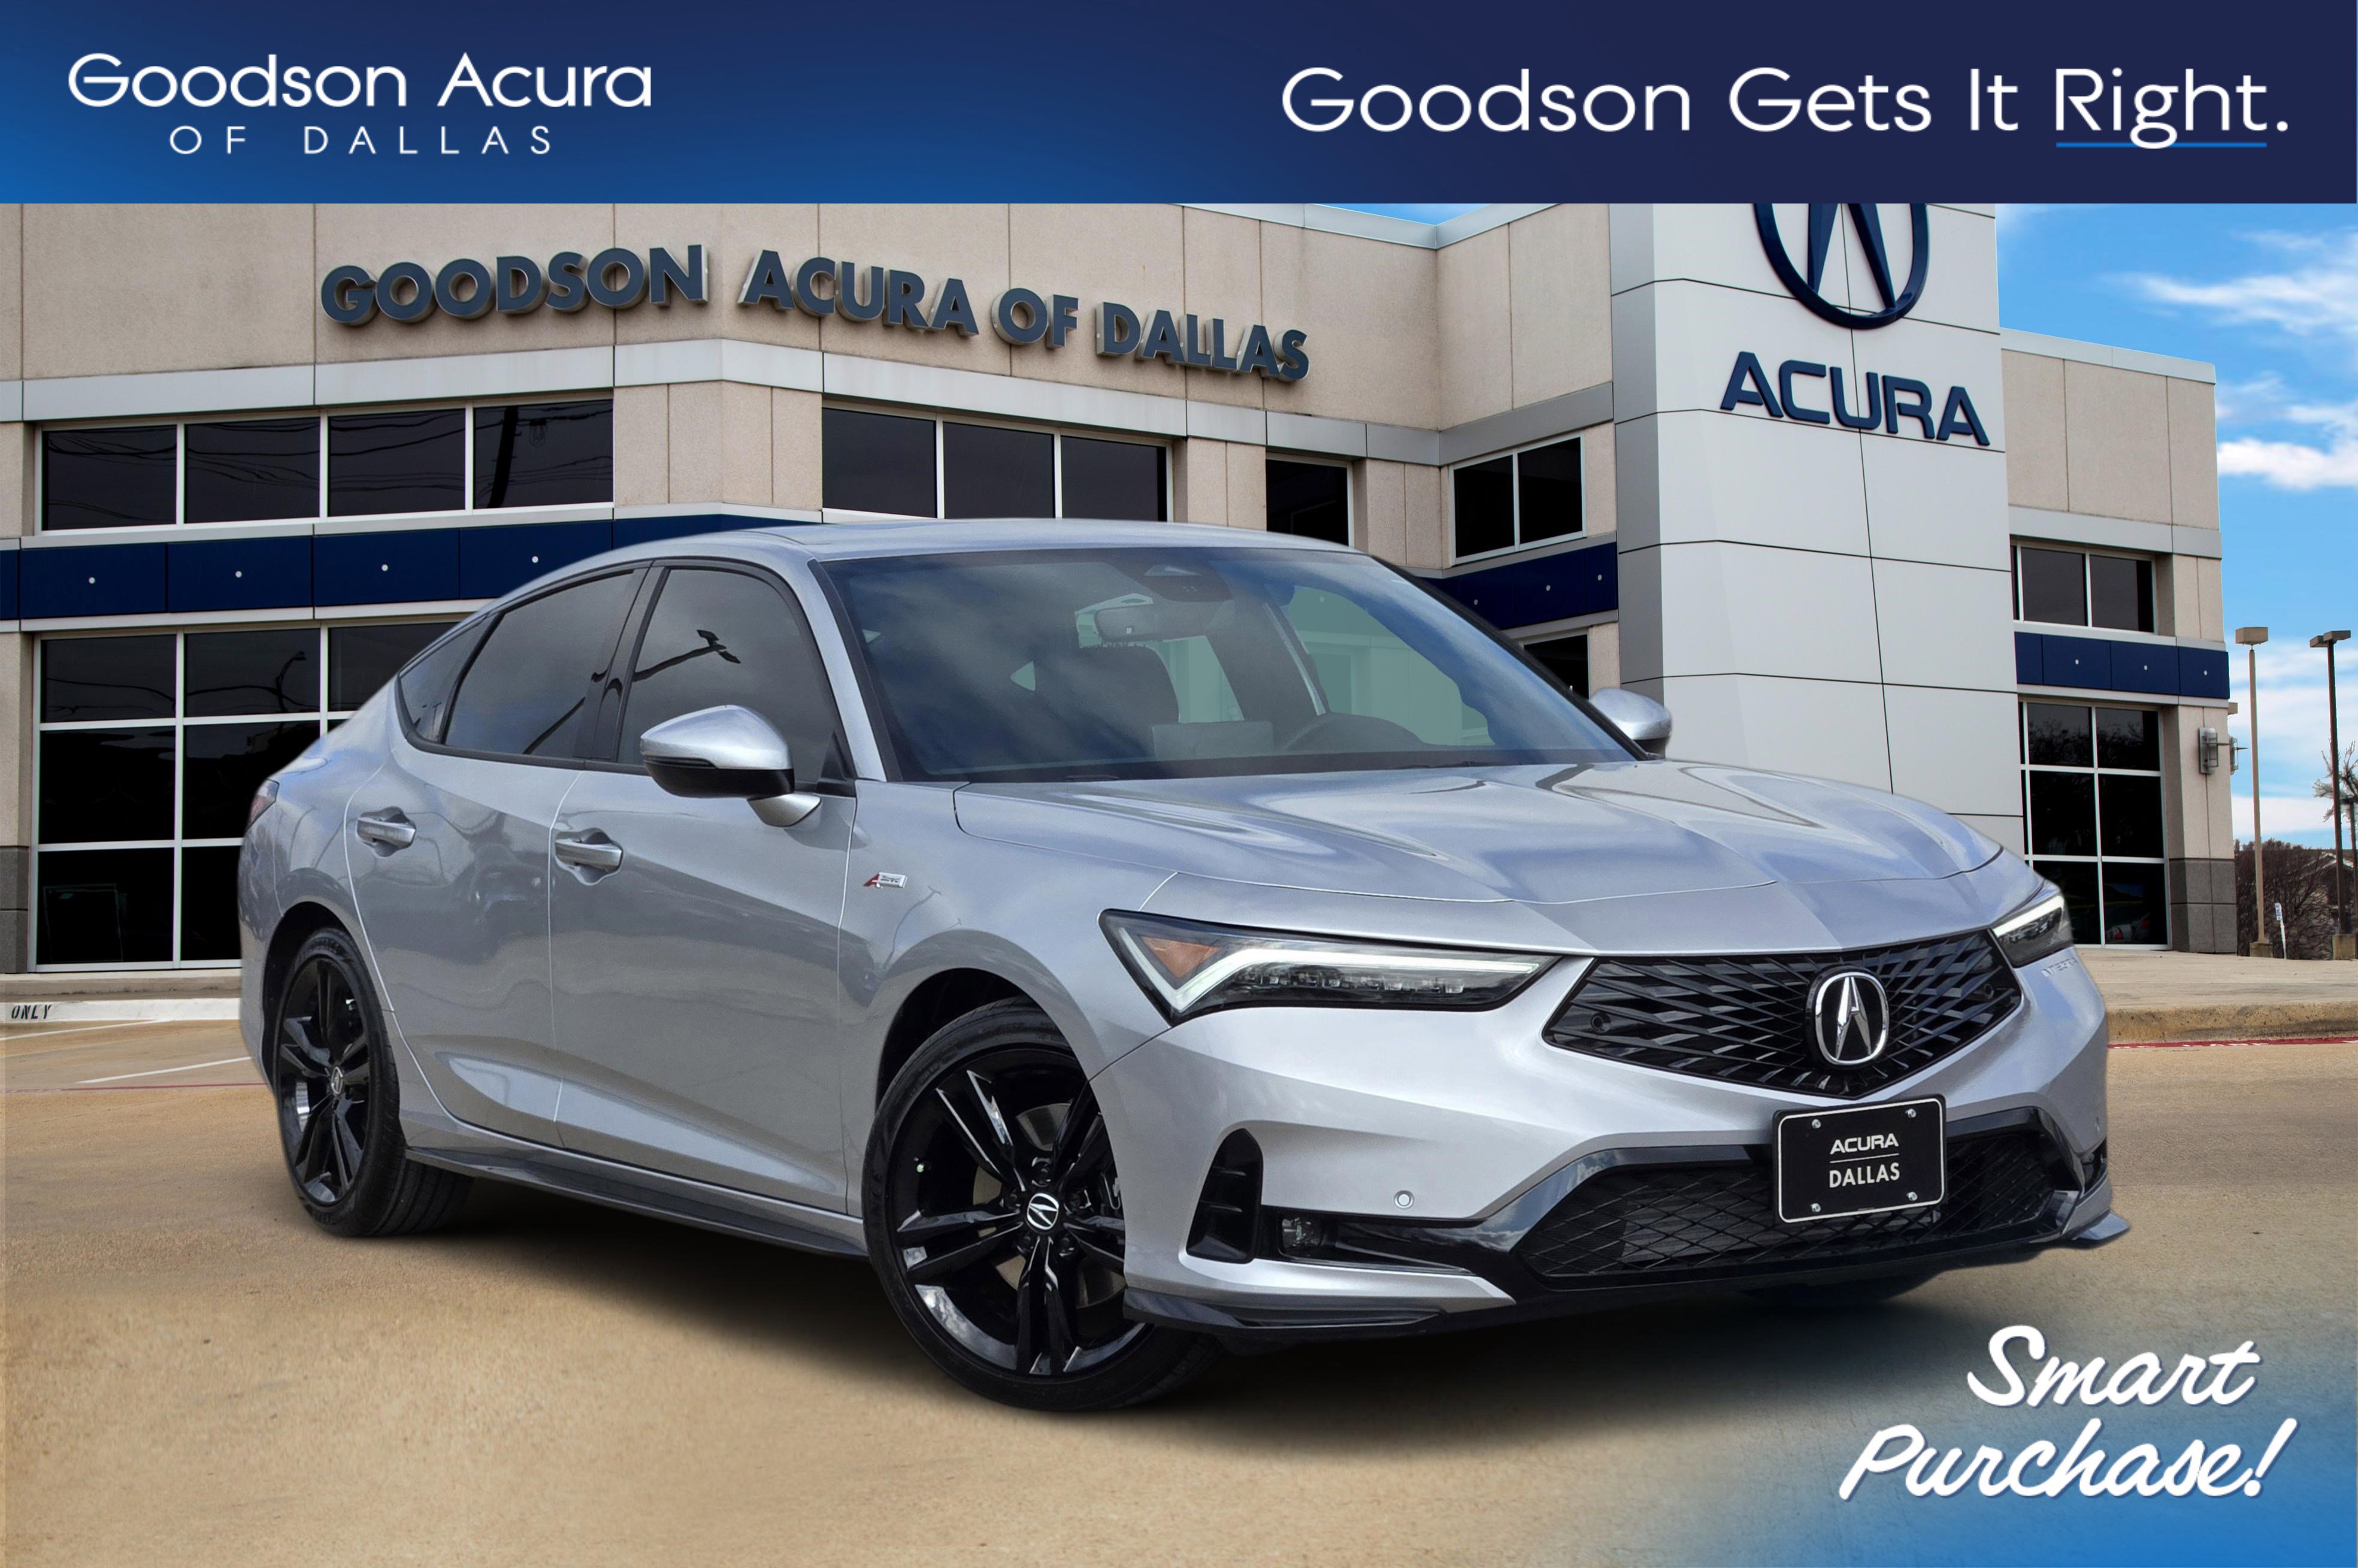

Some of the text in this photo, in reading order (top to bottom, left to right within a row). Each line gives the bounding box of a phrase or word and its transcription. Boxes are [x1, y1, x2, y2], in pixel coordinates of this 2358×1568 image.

[320, 244, 1310, 382] GOODSON ACURA OF DALLAS
[1720, 351, 1990, 446] ACURA
[11, 1004, 52, 1019] ONLY
[1830, 1133, 1899, 1155] ACURA
[1829, 1163, 1900, 1188] DALLAS
